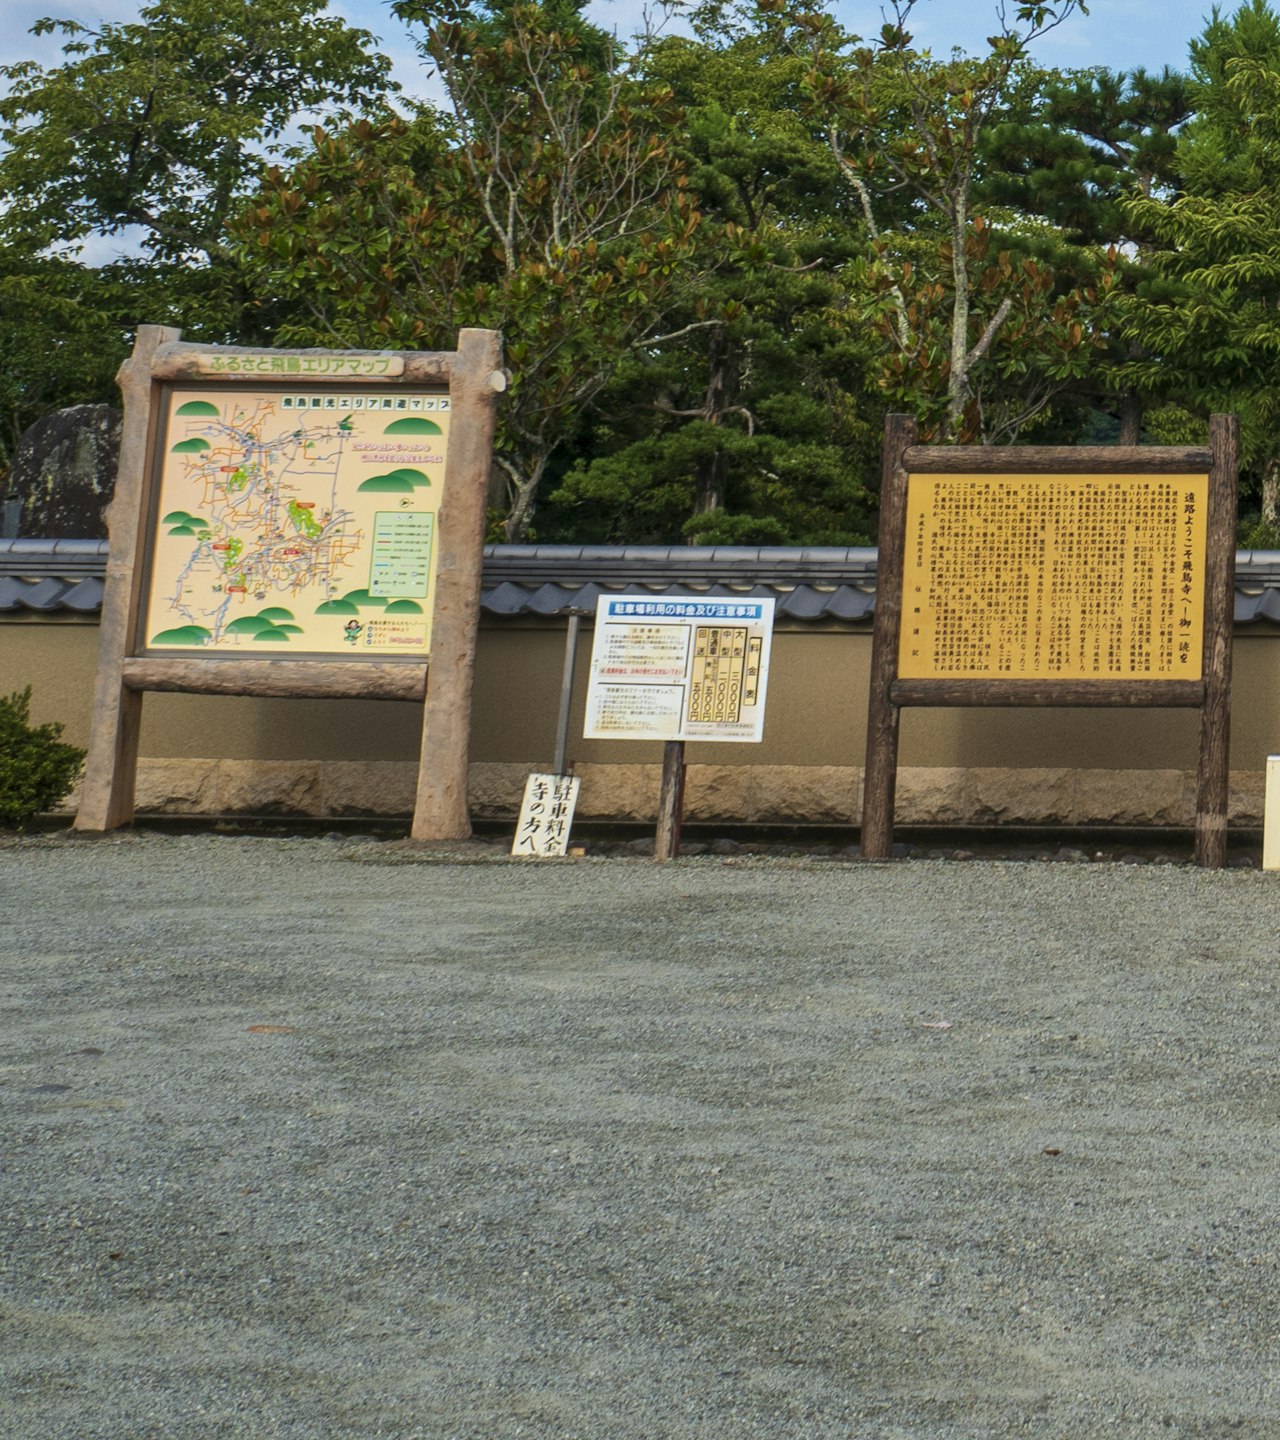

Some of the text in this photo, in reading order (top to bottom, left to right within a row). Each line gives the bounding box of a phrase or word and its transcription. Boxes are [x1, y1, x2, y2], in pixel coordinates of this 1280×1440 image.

[209, 356, 391, 373] ふるさと飛鳥エリアマップ
[613, 603, 757, 617] 駐車場利用の料金及び注意事項
[721, 631, 732, 656] 中型
[733, 631, 744, 656] 大型
[746, 643, 759, 699] 料金表
[520, 782, 548, 851] 寺の方へ
[543, 784, 572, 853] 駐車料金
